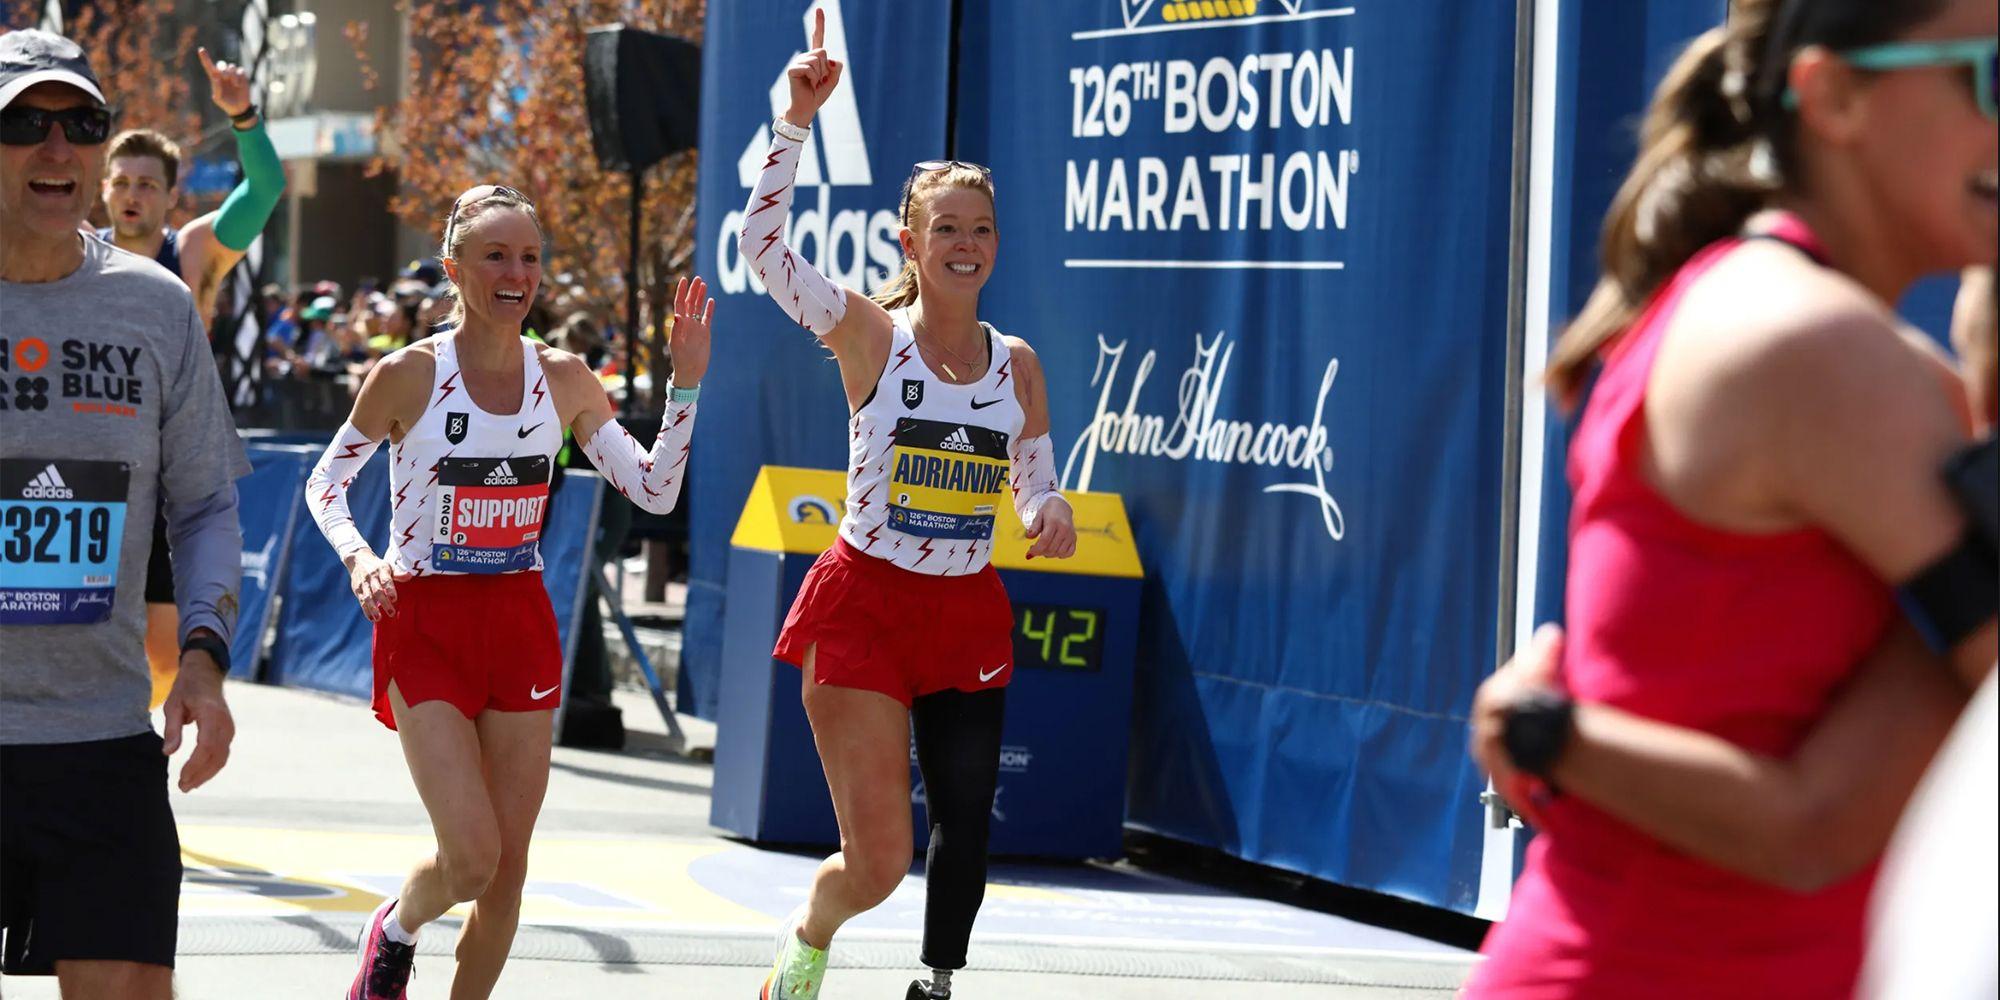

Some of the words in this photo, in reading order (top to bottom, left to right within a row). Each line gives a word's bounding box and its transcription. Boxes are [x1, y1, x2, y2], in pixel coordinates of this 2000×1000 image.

[1069, 61, 1160, 137] 126TH
[1164, 47, 1354, 133] BOSTON
[717, 183, 901, 295] adas
[62, 339, 142, 376] SKY
[62, 373, 142, 404] BLUE
[1058, 333, 1164, 494] John
[1161, 330, 1345, 541] Hancock
[940, 441, 975, 453] adidas
[484, 476, 519, 486] adidas
[893, 453, 1010, 494] ADRIANNE
[22, 486, 74, 499] adidas
[901, 495, 908, 504] P
[440, 494, 452, 536] S206
[457, 495, 548, 528] SUPPORT
[927, 514, 957, 523] BOSTON
[909, 518, 956, 530] MARATHON
[0, 506, 110, 565] 3219
[457, 534, 464, 543] P
[456, 555, 507, 565] MARATHON
[0, 601, 60, 612] ARATHON
[15, 592, 60, 601] BOSTON
[1022, 609, 1097, 666] 42
